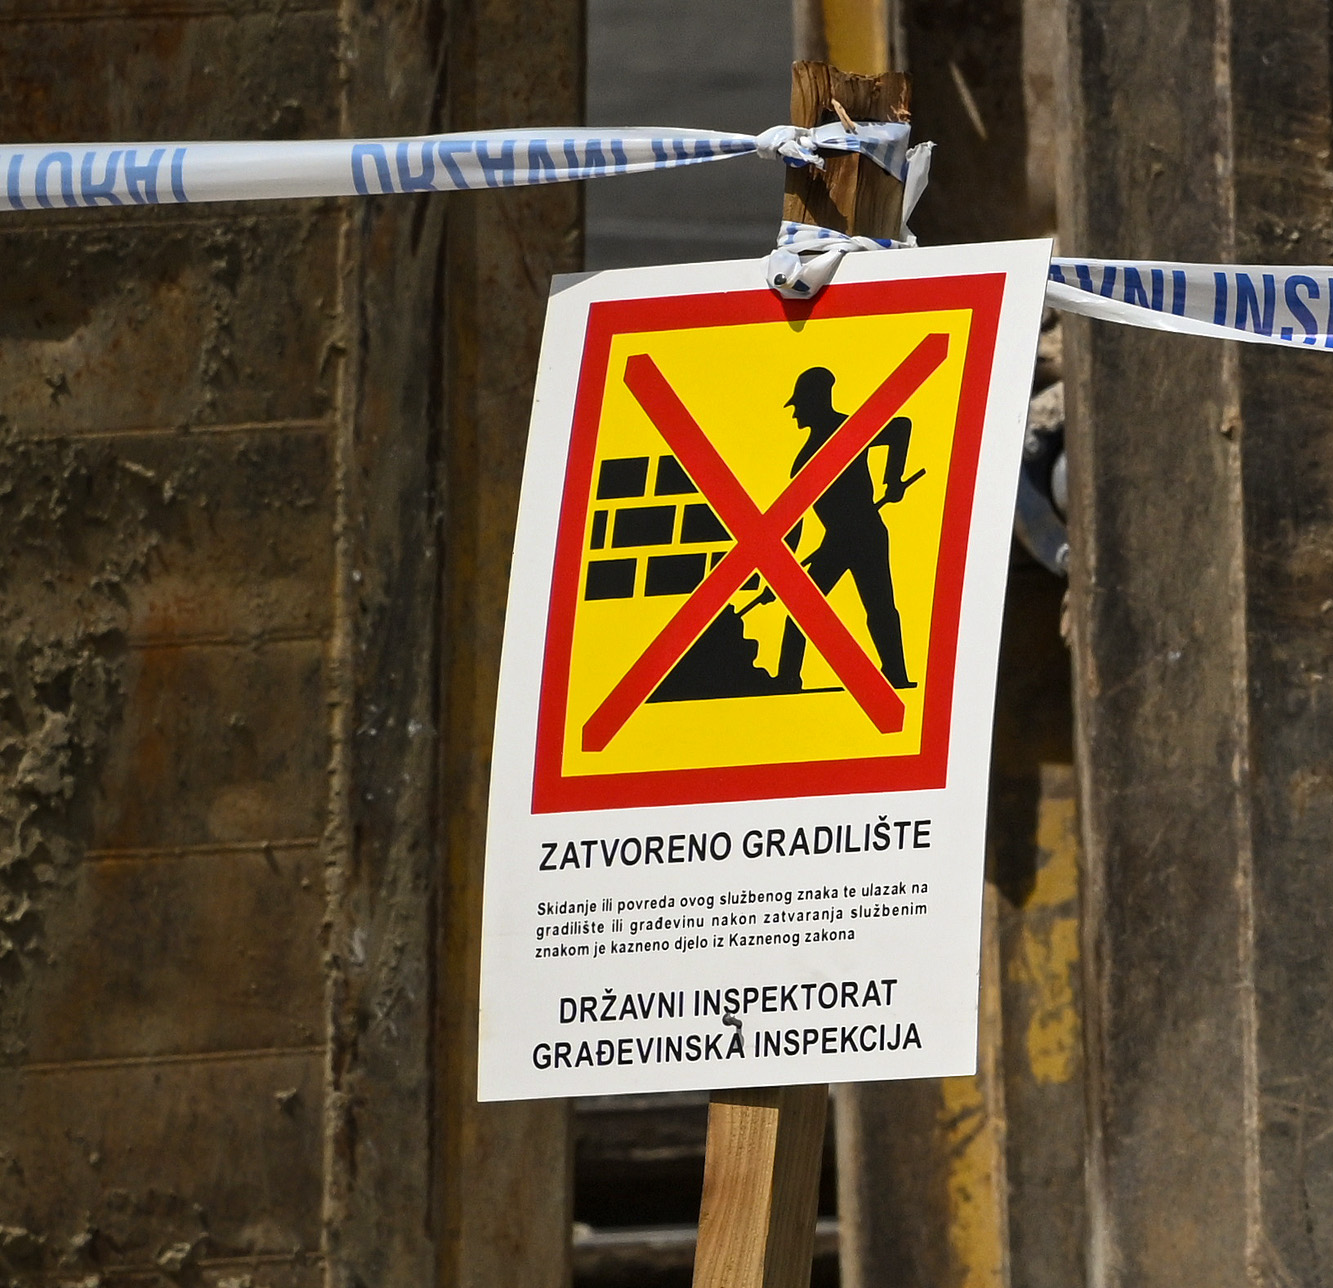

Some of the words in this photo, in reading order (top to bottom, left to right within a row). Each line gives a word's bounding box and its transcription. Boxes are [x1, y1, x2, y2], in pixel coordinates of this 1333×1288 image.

[539, 831, 732, 871] ZATVORENO
[742, 814, 932, 860] GRADILIŠTE
[537, 900, 597, 916] Skidanje
[601, 898, 613, 912] ili
[617, 895, 675, 915] povreda
[680, 895, 715, 910] ovog
[719, 890, 793, 906] službenog
[797, 885, 839, 901] znaka
[843, 884, 857, 899] te
[861, 881, 906, 897] ulazak
[911, 883, 928, 895] na
[536, 921, 605, 941] gradilište
[611, 918, 623, 933] ili
[629, 916, 704, 936] građevinu
[711, 912, 757, 927] nakon
[763, 906, 843, 924] zatvaranja
[850, 902, 927, 919] službenim
[535, 943, 590, 958] znakom
[593, 941, 606, 959] je
[610, 940, 670, 954] kazneno
[674, 935, 708, 953] djelo
[712, 934, 724, 948] iz
[729, 932, 800, 947] Kaznenog
[804, 928, 855, 943] zakona
[559, 988, 684, 1024] DRŽAVNI
[694, 979, 898, 1017] INSPEKTORAT
[532, 1033, 745, 1070] GRAĐEVINSKA
[754, 1022, 922, 1058] INSPEKCIJA
